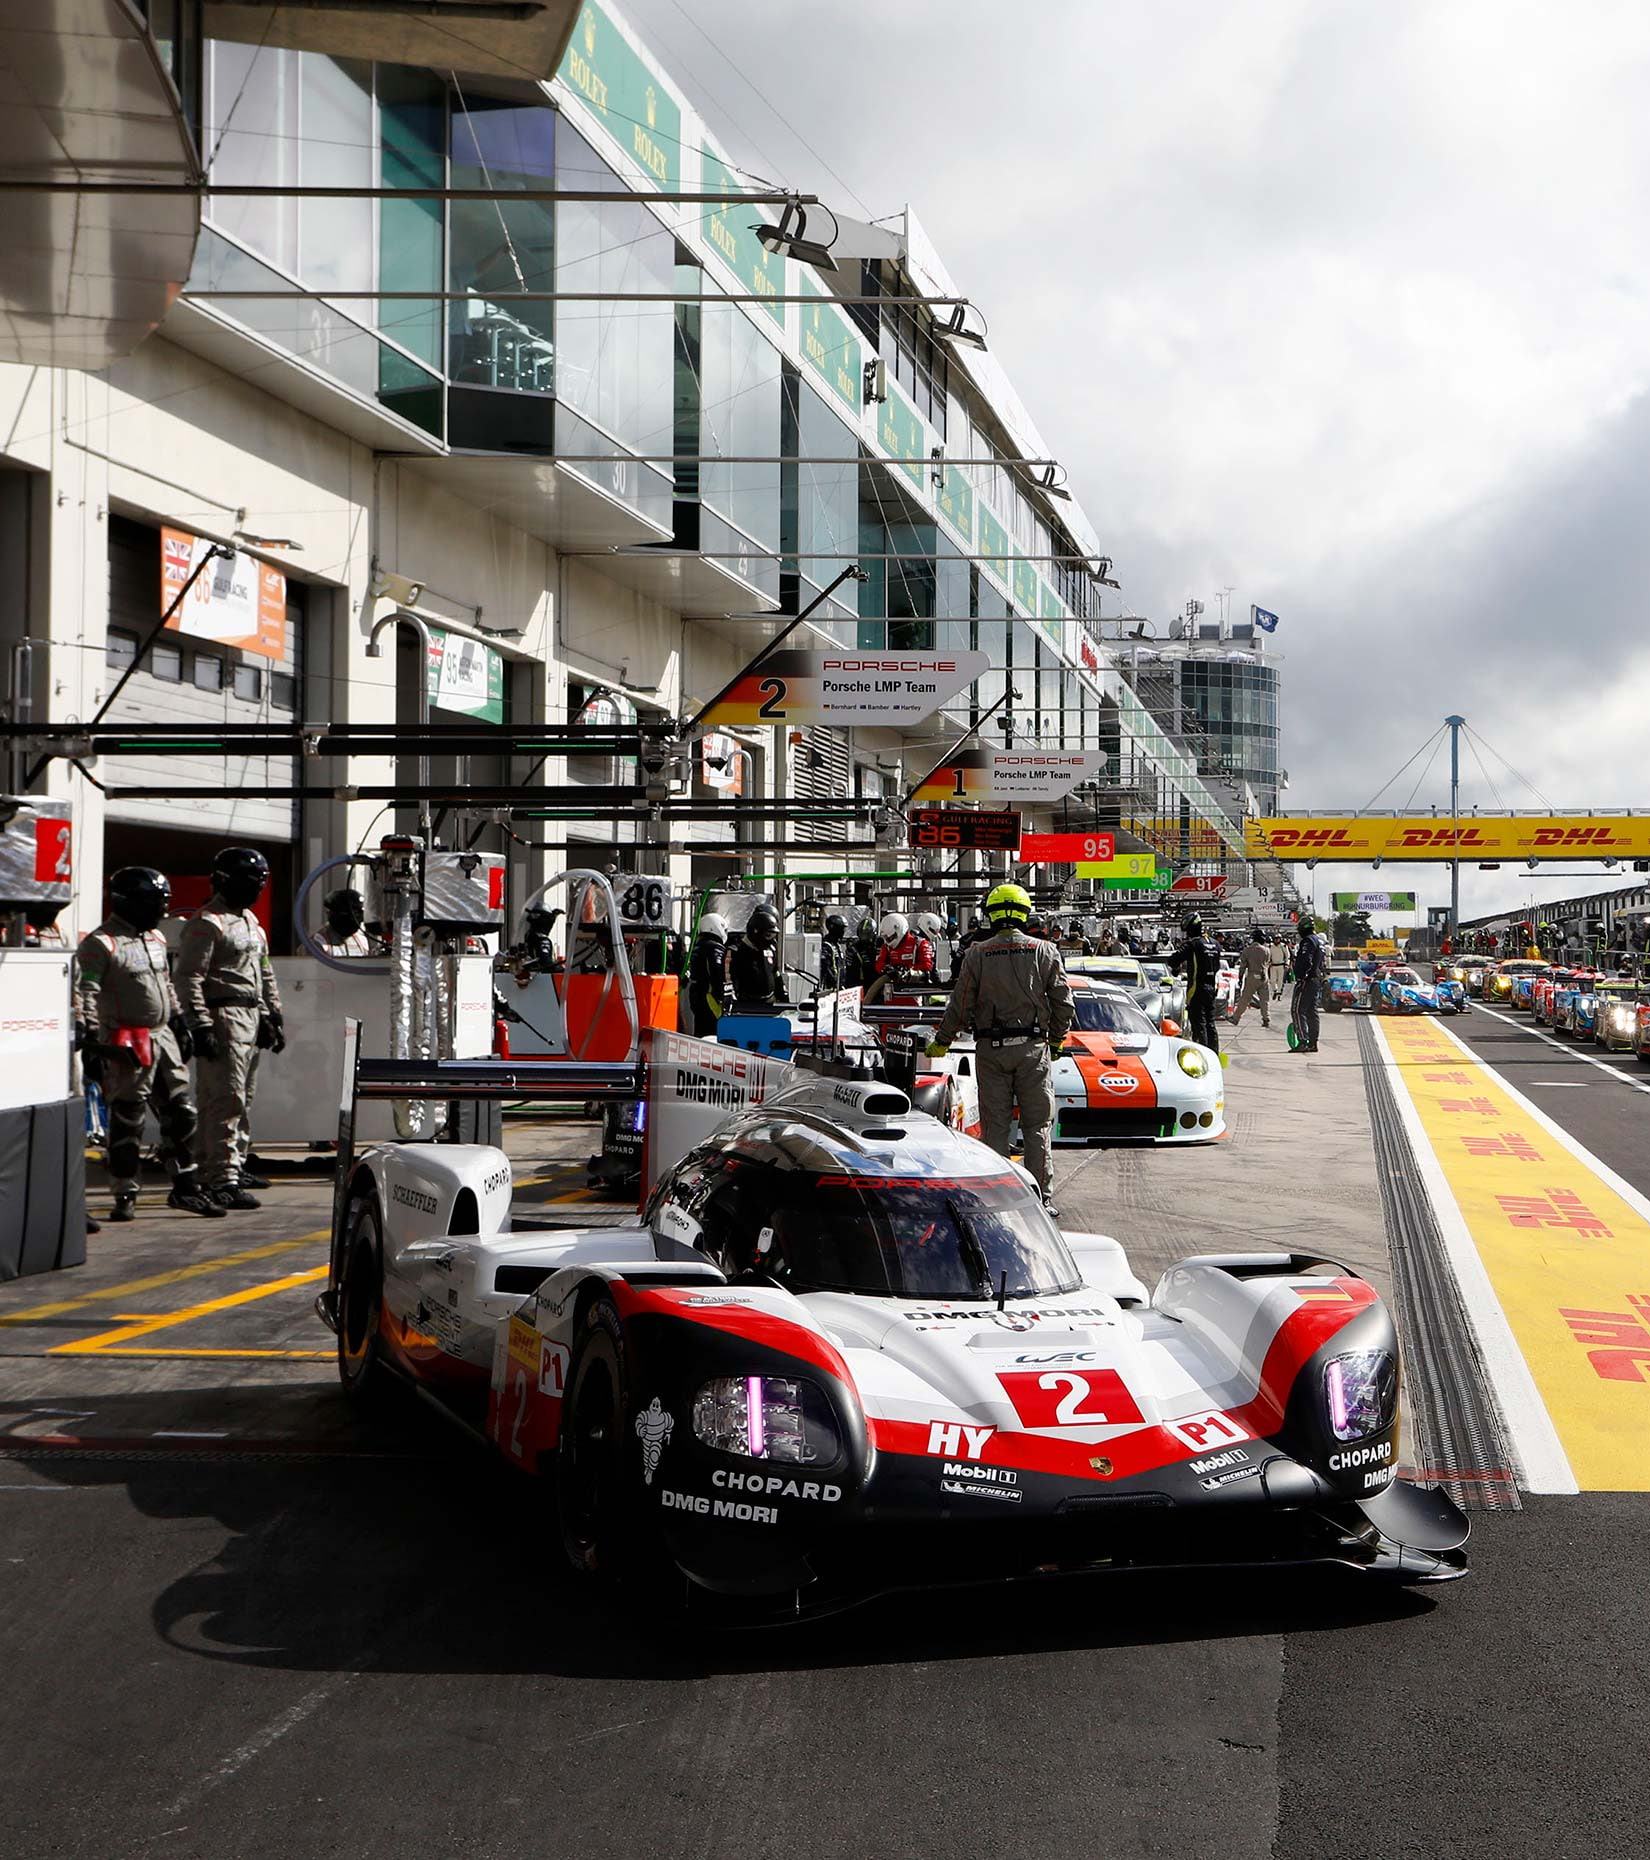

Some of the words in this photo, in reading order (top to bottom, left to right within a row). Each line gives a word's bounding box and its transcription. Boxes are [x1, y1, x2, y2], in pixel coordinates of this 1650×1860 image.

[569, 47, 608, 116] ROLEX
[634, 123, 667, 184] ROLEX
[710, 214, 736, 264] ROLEX
[446, 652, 457, 686] 95
[823, 660, 956, 672] PORSCHE
[822, 680, 871, 692] Porsche
[875, 680, 902, 692] LMP
[905, 680, 936, 693] Team
[758, 677, 788, 719] 2
[994, 757, 1085, 765] PORSCHE
[952, 768, 967, 797] 1
[994, 770, 1027, 779] Porsche
[1029, 770, 1048, 779] LMP
[1050, 770, 1071, 779] Team
[970, 816, 1013, 826] RACING
[918, 825, 961, 845] 86
[1270, 829, 1354, 847] DHL
[1401, 828, 1485, 846] DHL
[1532, 827, 1617, 845] DHL
[55, 827, 71, 875] 2
[1083, 838, 1111, 859] 95
[1129, 858, 1151, 875] 97
[1196, 877, 1212, 891] 91
[1257, 886, 1268, 897] 13
[621, 883, 662, 921] 86
[1364, 894, 1384, 902] #WEC
[2, 1019, 58, 1031] PORSCHE
[886, 1033, 913, 1048] CHOPARD
[667, 1038, 747, 1079] PORSCHE
[676, 1069, 708, 1104] DMG
[708, 1078, 746, 1112] MORI
[1100, 1076, 1136, 1087] Gulf
[816, 1175, 1023, 1190] PORSCHE
[393, 1184, 438, 1215] SCHAEFFLER
[1495, 1188, 1614, 1238] DHL
[903, 1311, 997, 1321] DMG
[999, 1308, 1102, 1319] MORI
[1016, 1352, 1096, 1364] WEC
[543, 1347, 564, 1391] P1
[1038, 1372, 1109, 1424] 2
[1178, 1416, 1236, 1445] P1
[927, 1422, 995, 1459] HY
[1189, 1452, 1234, 1475] Mobil
[1329, 1441, 1391, 1471] CHOPARD
[943, 1463, 997, 1481] Mobil
[1219, 1466, 1258, 1483] MICHELIN
[1364, 1472, 1388, 1489] DMG
[711, 1468, 842, 1503] CHOPARD
[965, 1484, 1020, 1499] MICHELIN
[661, 1490, 710, 1514] DMG
[712, 1499, 778, 1525] MORI
